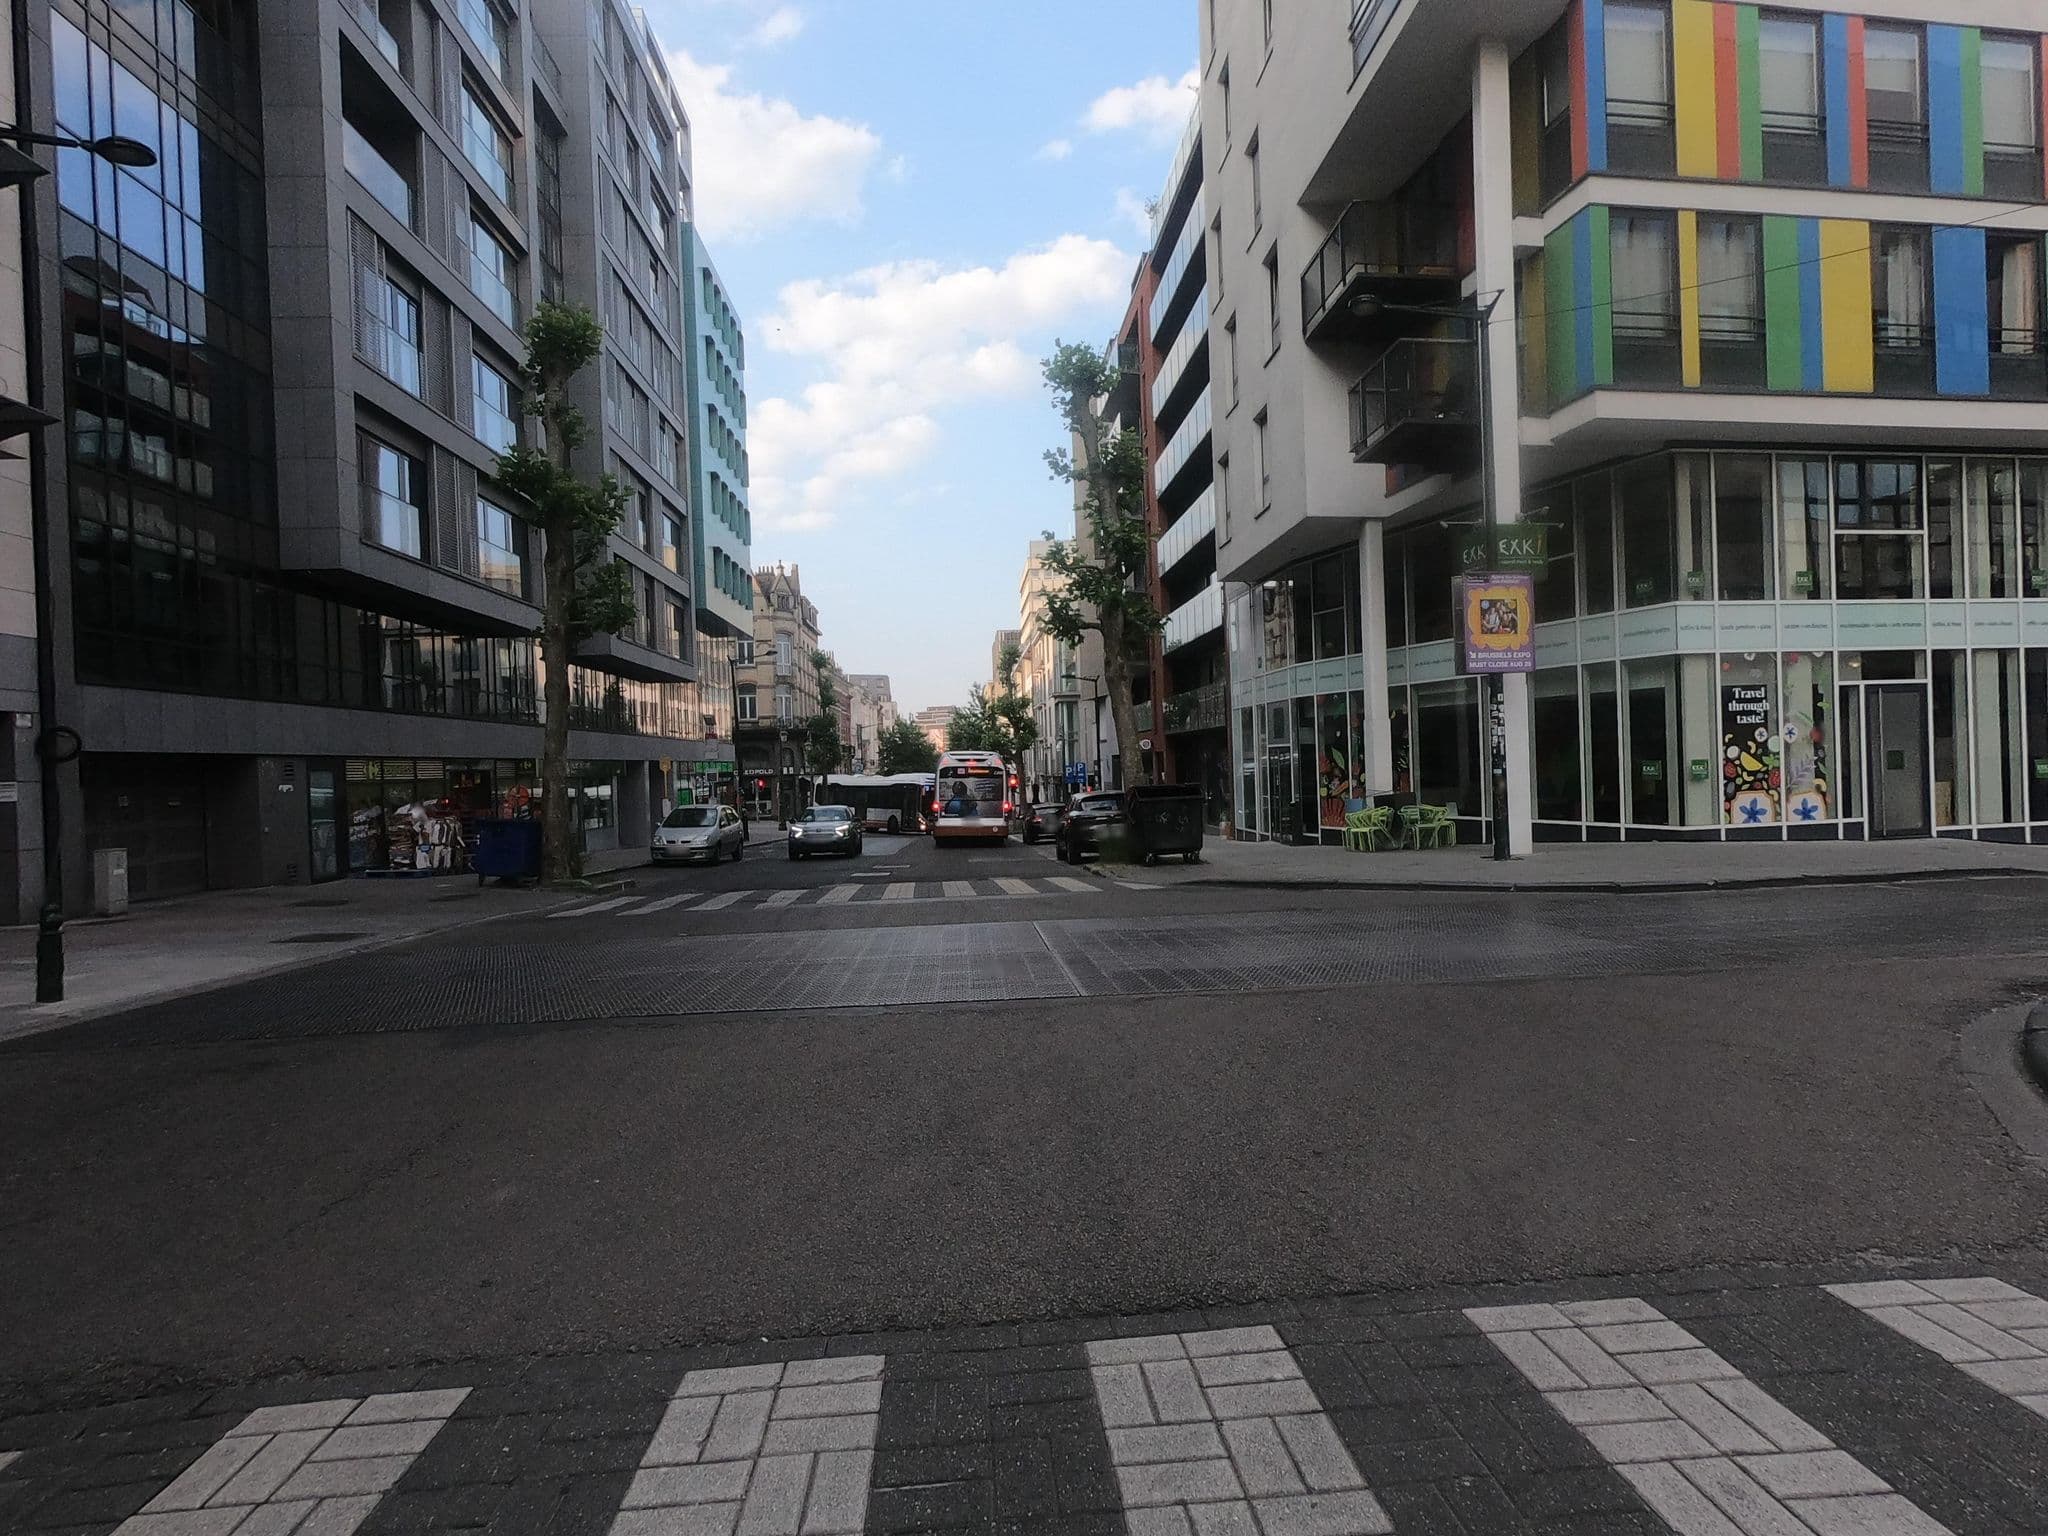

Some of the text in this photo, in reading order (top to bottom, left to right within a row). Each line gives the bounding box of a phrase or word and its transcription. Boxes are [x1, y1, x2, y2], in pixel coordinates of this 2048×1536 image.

[1477, 651, 1512, 659] BRUSSELS
[1732, 687, 1765, 699] Travel
[1728, 700, 1770, 715] through
[1736, 712, 1765, 724] taste!
[1065, 767, 1072, 777] P
[1077, 763, 1084, 772] P
